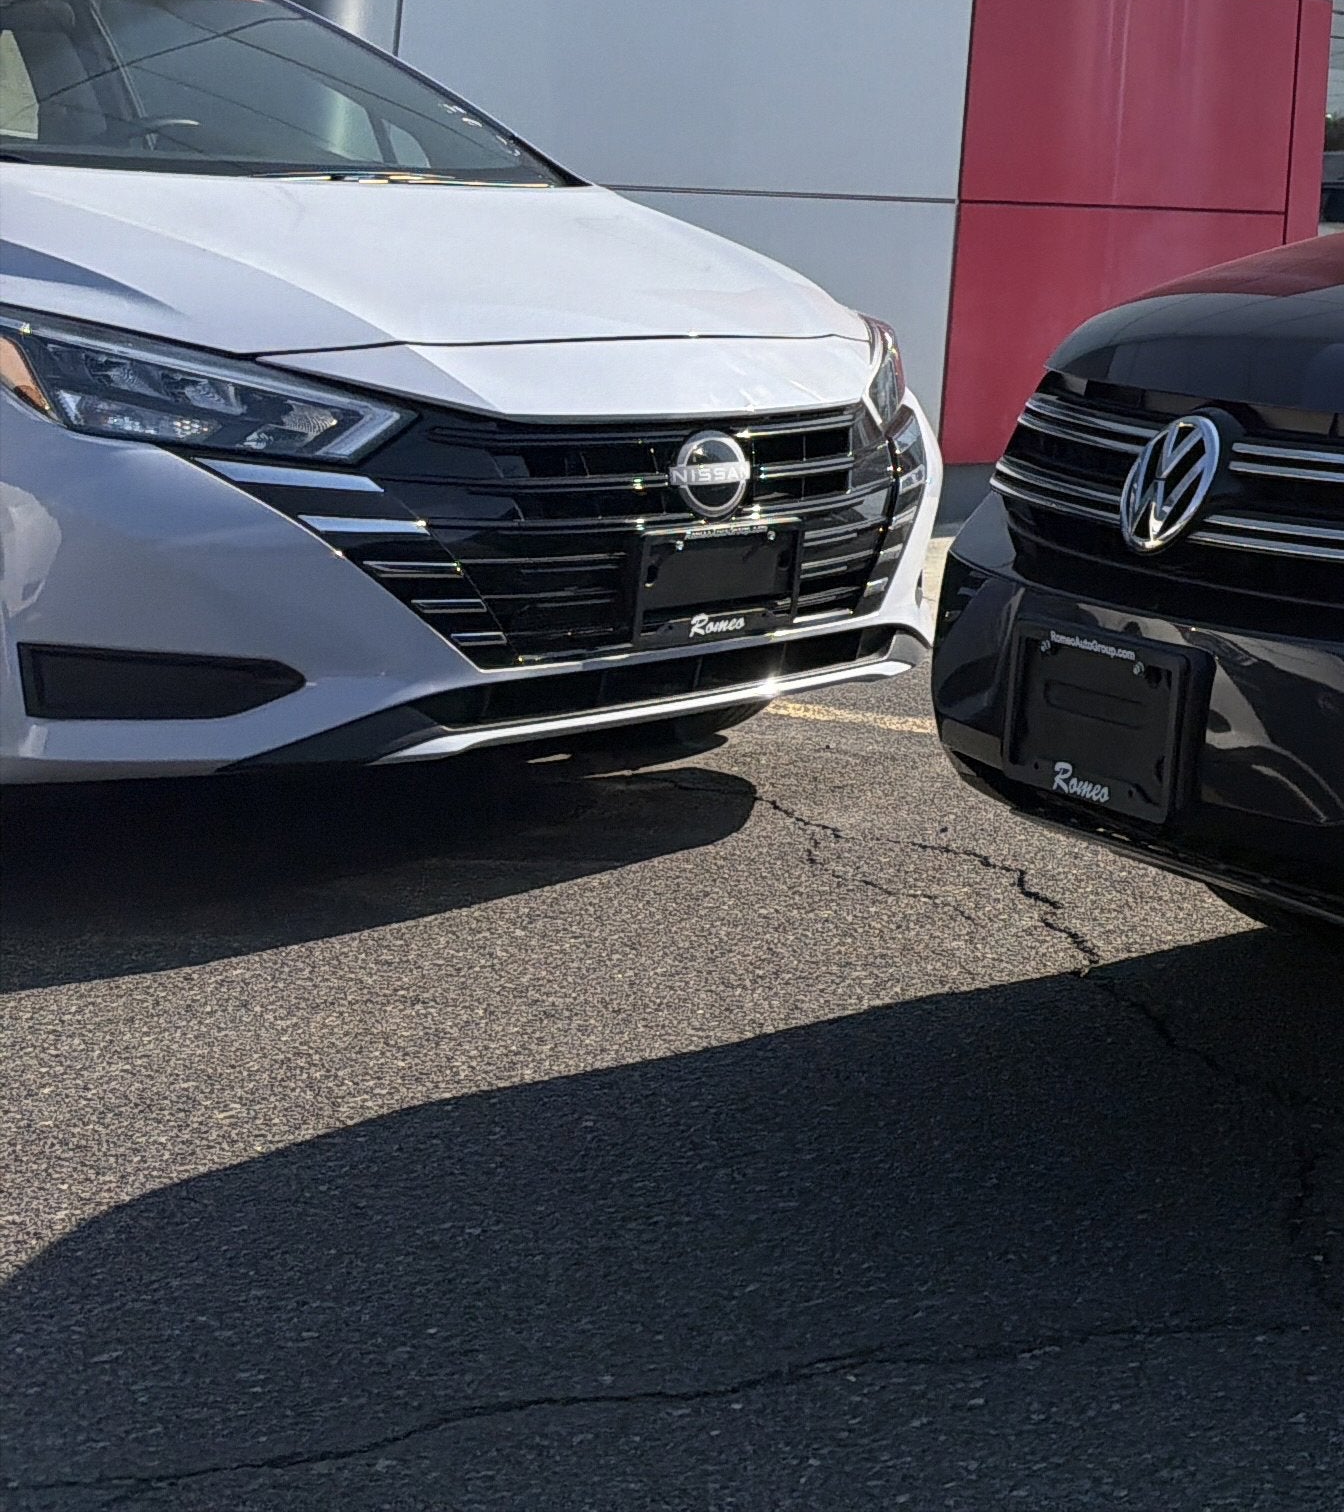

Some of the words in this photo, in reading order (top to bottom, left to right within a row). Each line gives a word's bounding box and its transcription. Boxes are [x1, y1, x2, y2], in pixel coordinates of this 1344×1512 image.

[672, 466, 747, 483] NISSAN
[689, 613, 746, 638] Romeo
[1050, 630, 1135, 661] RomeoAutoGroup.com
[1053, 761, 1110, 803] Romeo
